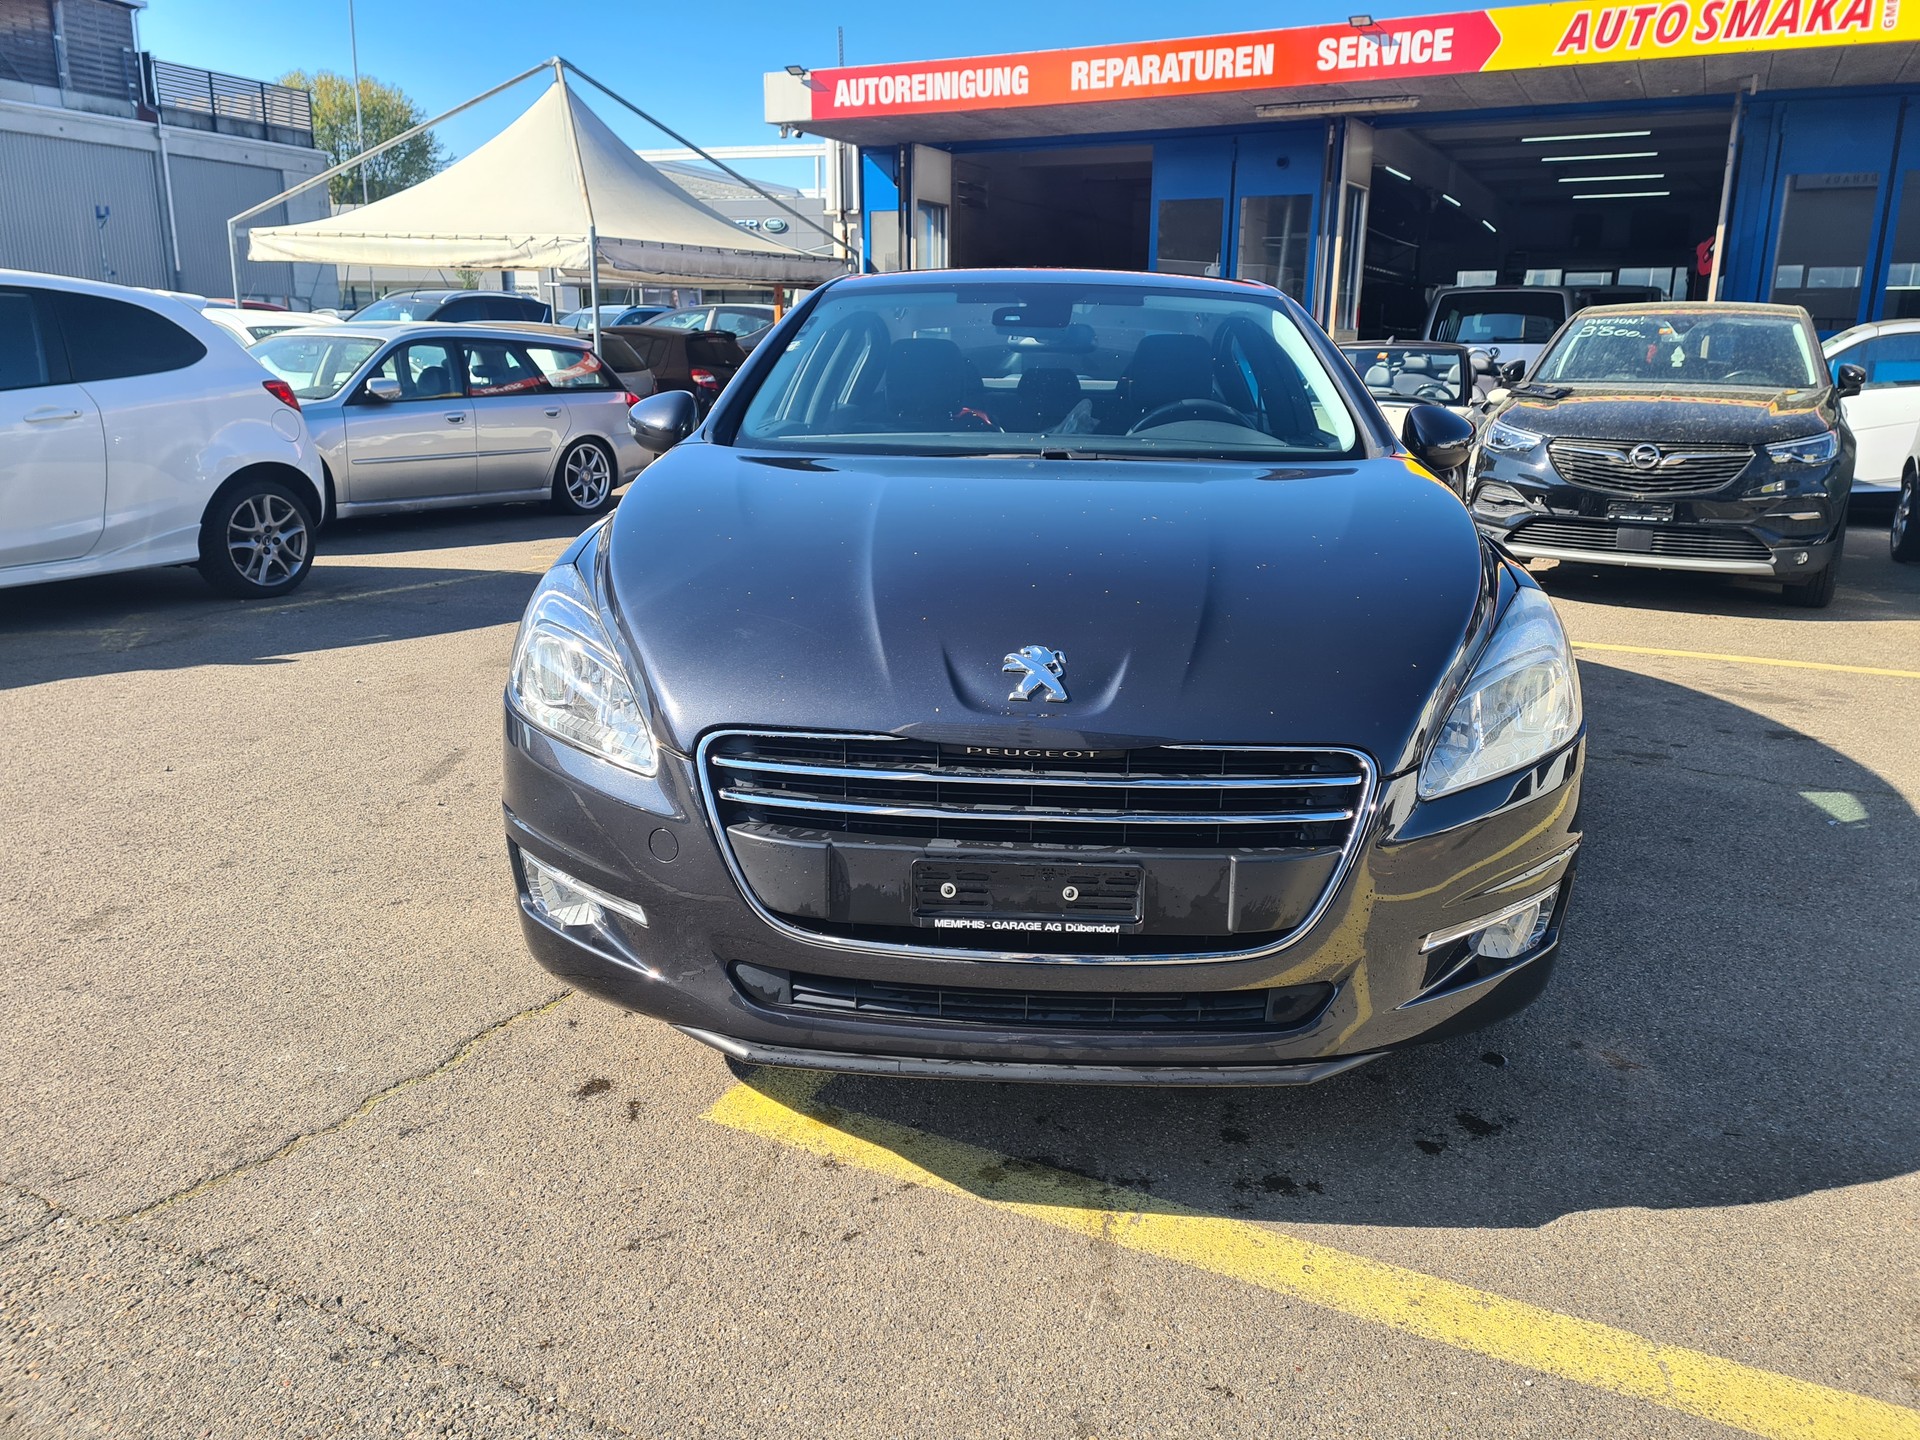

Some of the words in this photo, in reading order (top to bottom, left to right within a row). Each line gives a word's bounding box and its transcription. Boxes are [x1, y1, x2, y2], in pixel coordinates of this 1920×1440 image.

[834, 65, 1029, 107] AUTOREINIGUNG
[1071, 43, 1275, 91] REPARATUREN
[1316, 27, 1454, 71] SERVICE
[966, 746, 1100, 758] PEUGEOT
[1044, 922, 1062, 932] AG
[1065, 923, 1120, 934] Dübendorf
